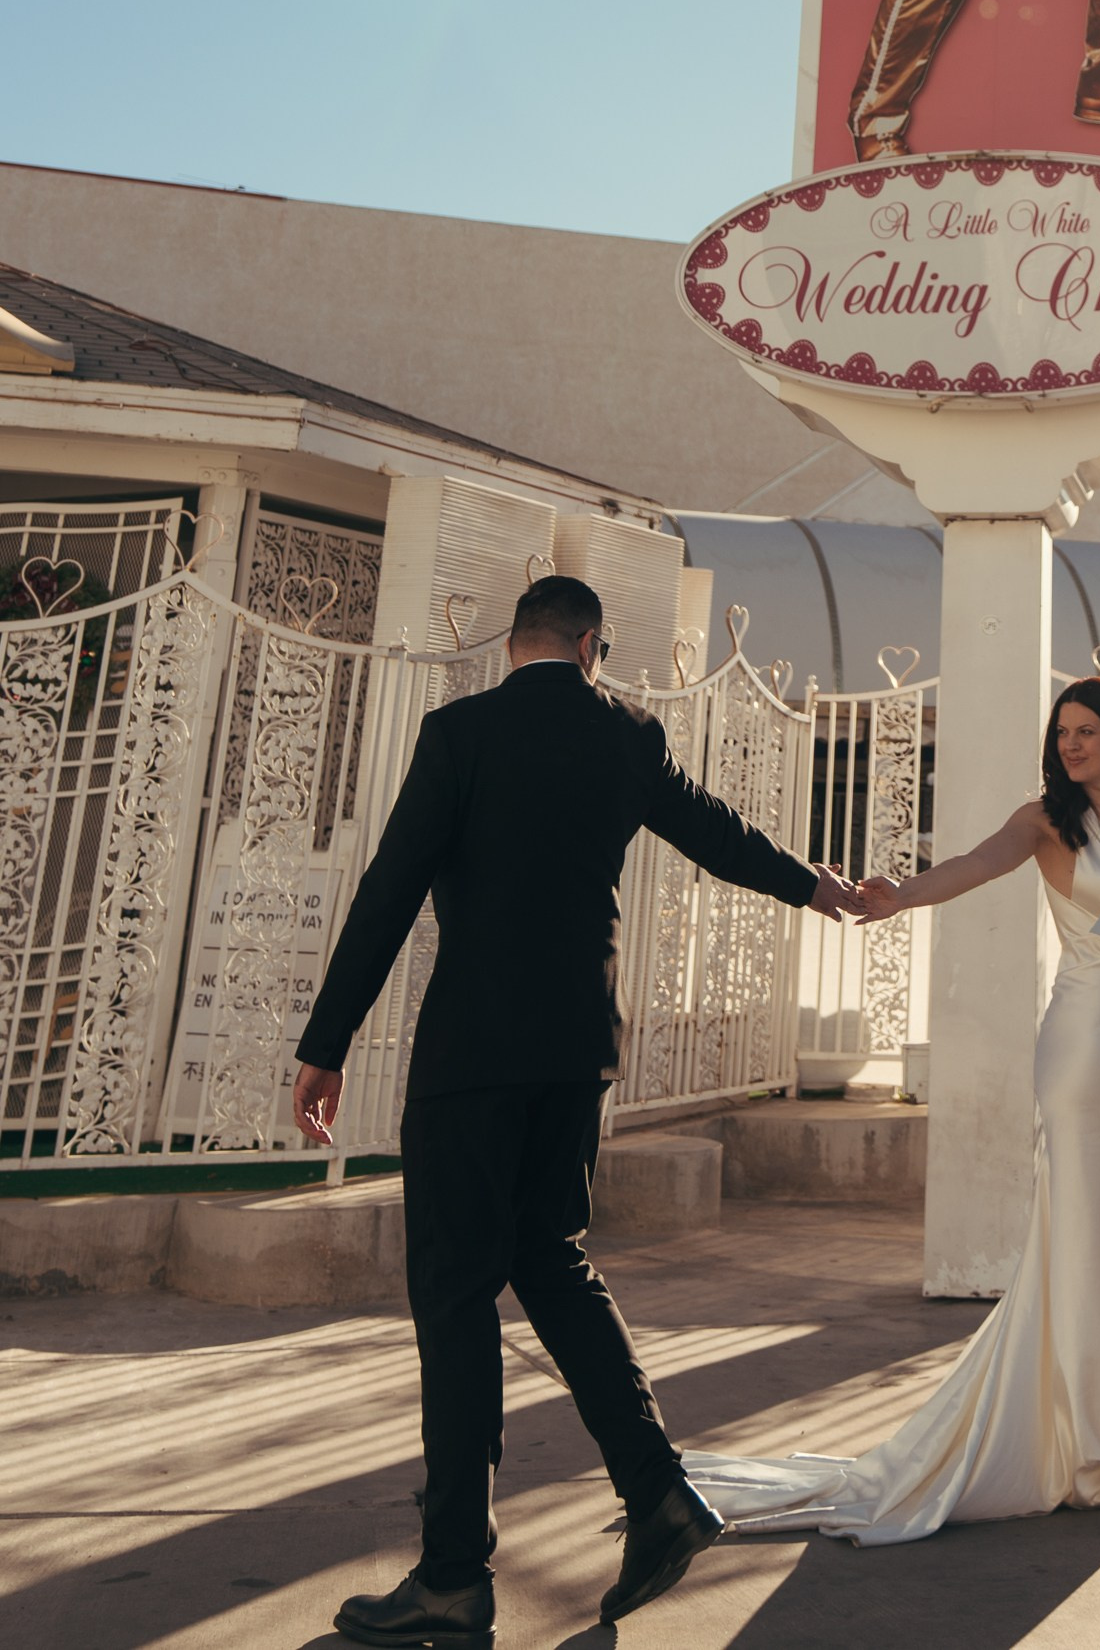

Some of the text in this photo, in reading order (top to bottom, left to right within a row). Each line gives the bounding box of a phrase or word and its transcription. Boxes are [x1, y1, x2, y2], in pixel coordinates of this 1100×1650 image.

[870, 199, 1090, 242] A Little White
[738, 245, 990, 338] Wedding
[210, 910, 225, 925] IN
[194, 993, 213, 1008] EN
